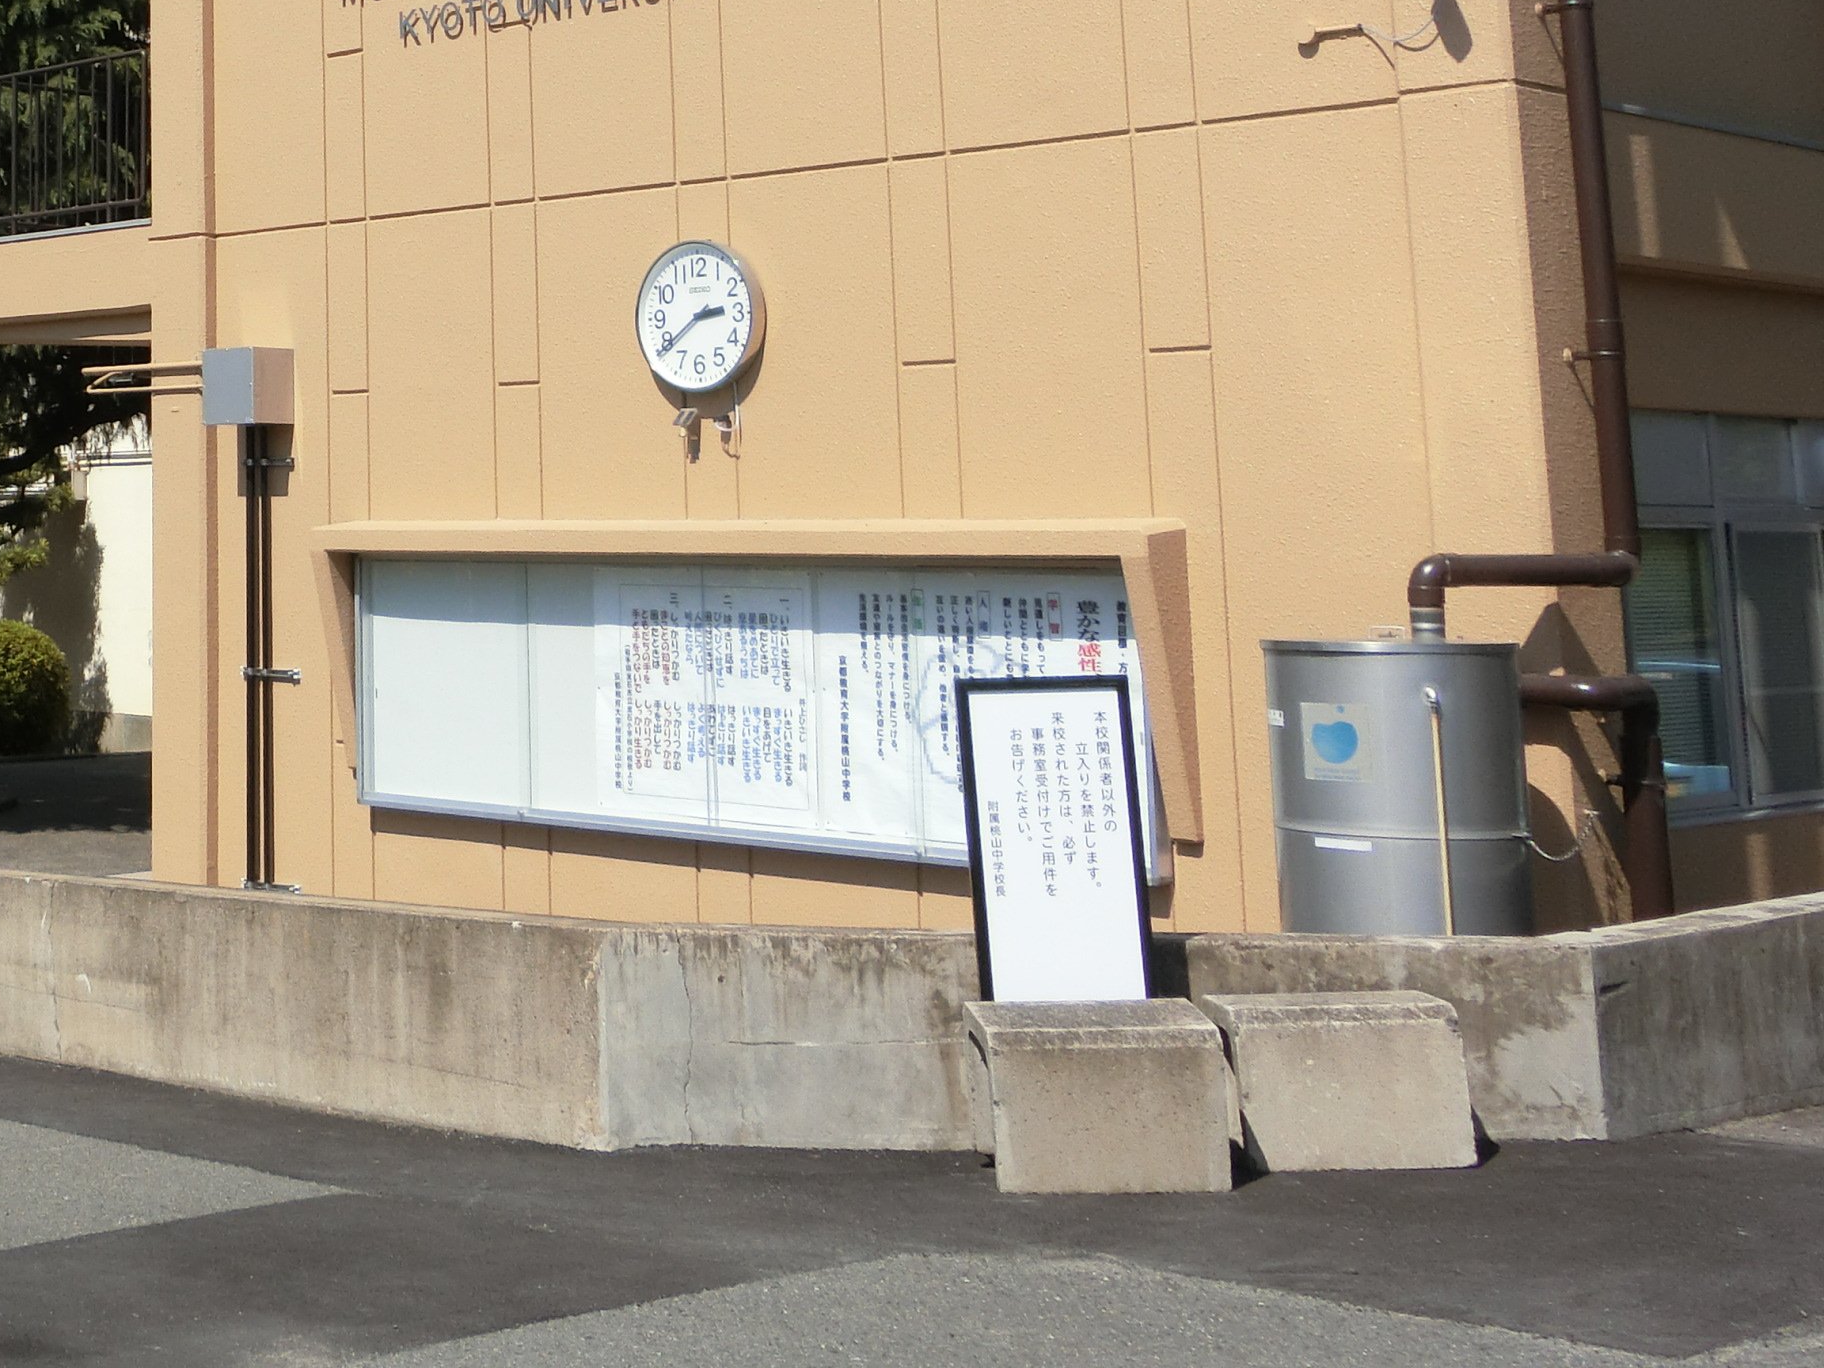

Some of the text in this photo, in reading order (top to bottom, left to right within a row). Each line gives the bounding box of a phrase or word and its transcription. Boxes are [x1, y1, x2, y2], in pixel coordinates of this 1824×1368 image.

[674, 264, 686, 285] 11
[690, 257, 707, 278] 12
[658, 284, 674, 304] 10
[726, 277, 738, 297] 2
[654, 309, 666, 329] 9
[732, 302, 745, 322] 3
[661, 331, 673, 351] 8
[727, 327, 739, 346] 4
[676, 350, 688, 369] 7
[694, 354, 706, 374] 6
[713, 347, 725, 366] 5
[1077, 600, 1102, 679] 豊かな感性
[1093, 711, 1118, 833] 本校関係者以外の
[1009, 728, 1033, 842] お告げください。
[1051, 711, 1077, 865] 来校された方は、必ず
[1030, 727, 1058, 897] 事務室受付けでご用件を
[1075, 741, 1103, 888] 立入りを禁止します。
[987, 800, 1006, 897] 附属桃山中学校長
